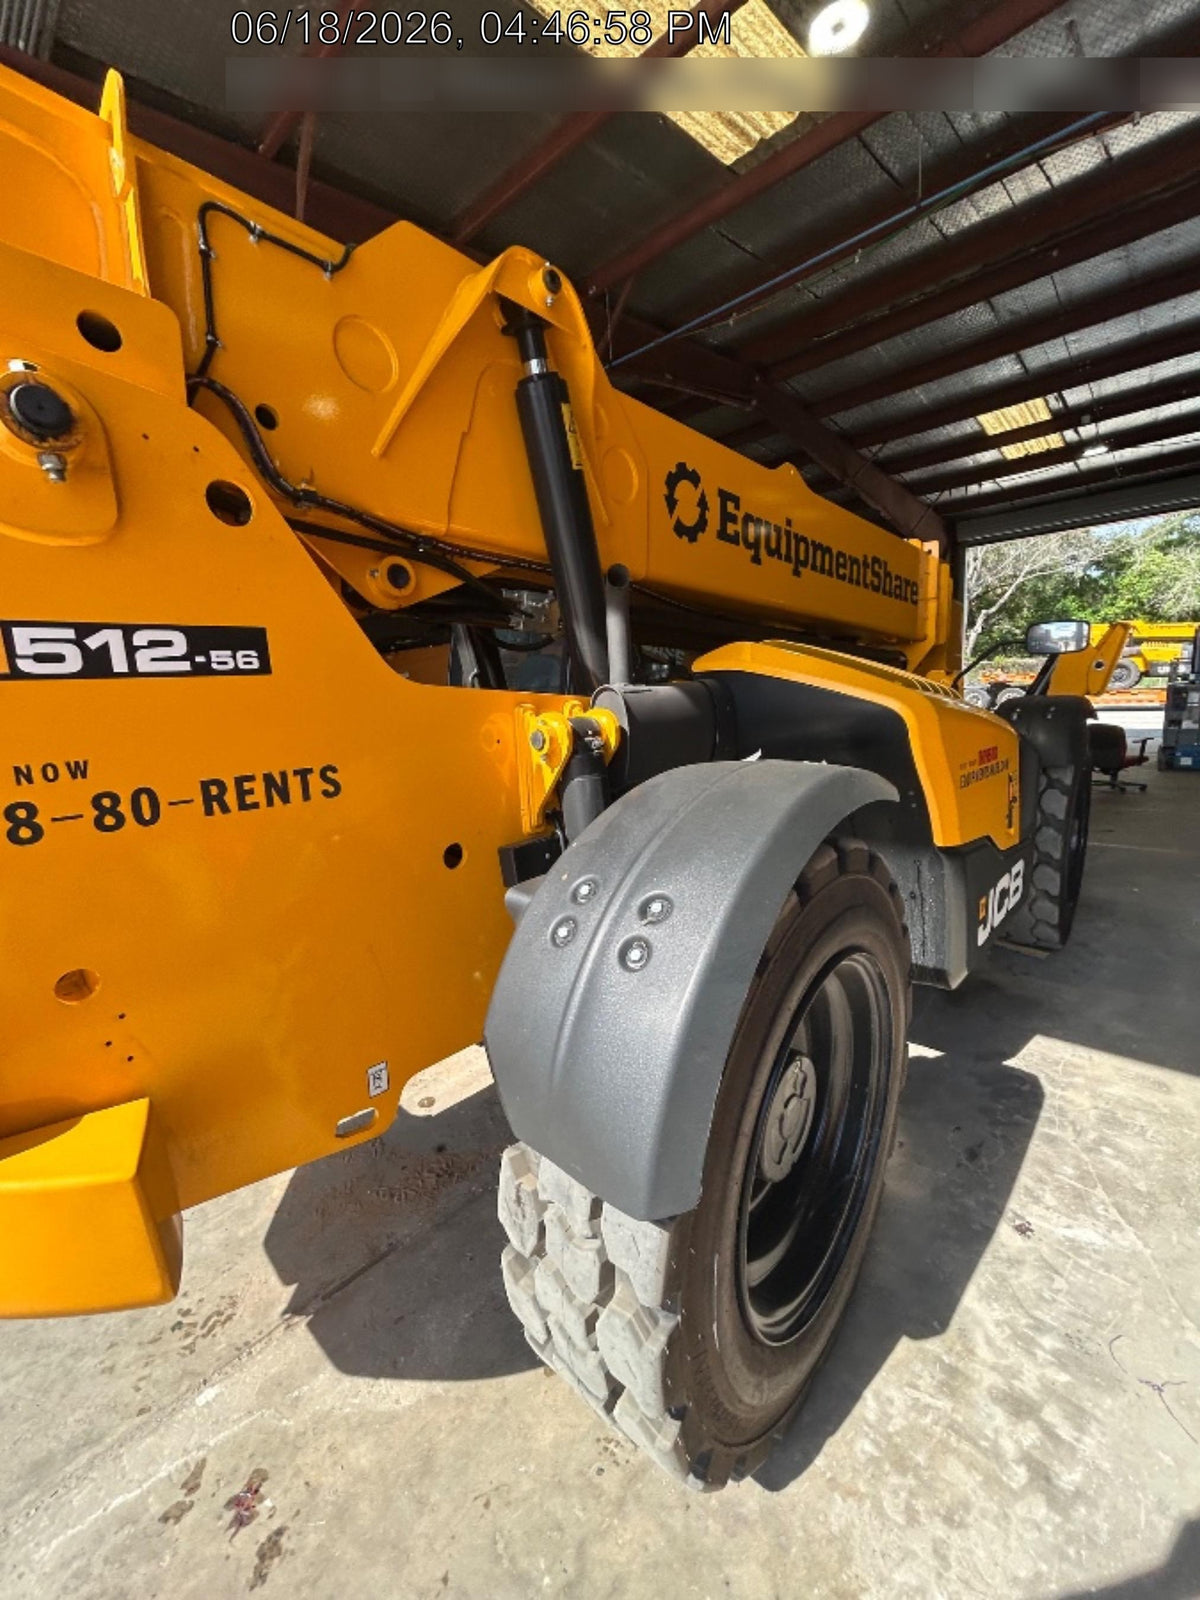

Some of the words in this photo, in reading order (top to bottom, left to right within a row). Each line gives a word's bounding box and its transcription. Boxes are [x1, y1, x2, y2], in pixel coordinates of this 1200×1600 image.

[716, 487, 918, 605] EquipmentShare
[11, 627, 260, 675] 512-56
[13, 760, 89, 786] NOW
[977, 859, 1025, 947] JCB
